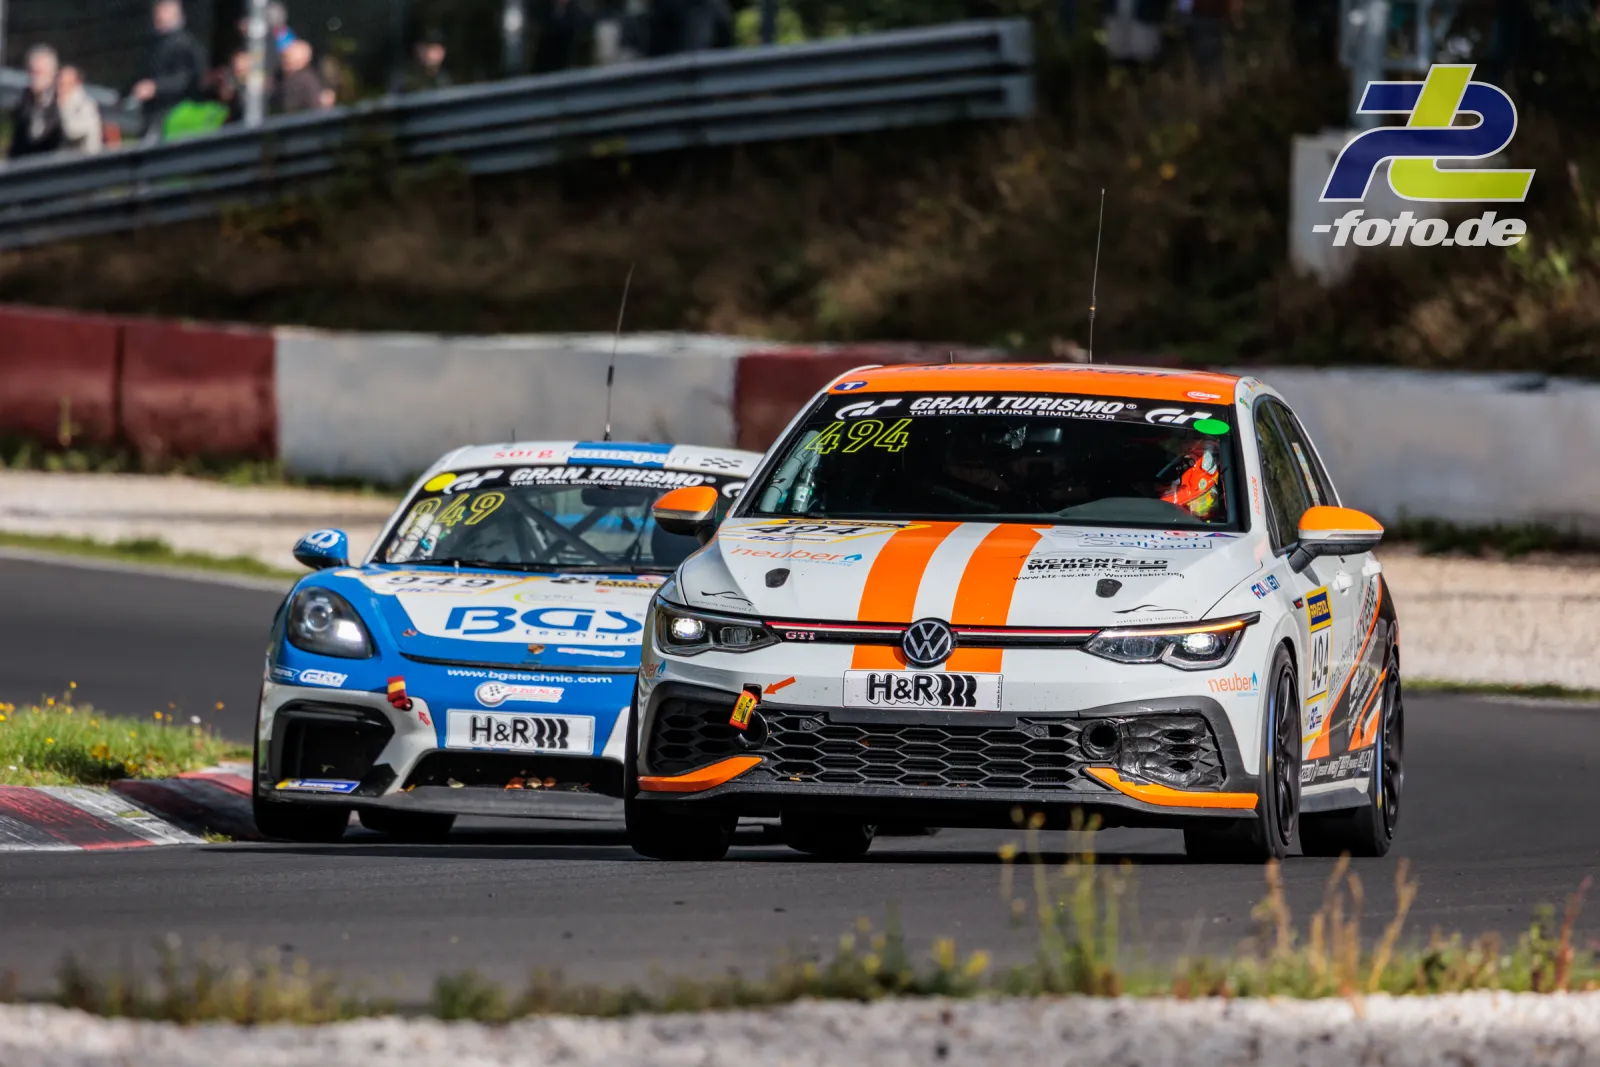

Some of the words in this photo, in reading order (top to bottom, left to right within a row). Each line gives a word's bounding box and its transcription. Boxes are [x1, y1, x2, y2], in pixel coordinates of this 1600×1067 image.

[909, 396, 993, 410] GRAN
[977, 408, 1033, 416] DRIVING
[1036, 411, 1115, 420] SIMULATOR
[804, 418, 913, 455] 494
[509, 466, 586, 481] GRAN
[747, 524, 867, 535] 494
[730, 547, 846, 561] neuber
[1029, 557, 1168, 566] SCHÖNFELD
[1027, 563, 1109, 571] WEBER
[1250, 574, 1281, 600] FALKEN
[445, 606, 643, 635] BGS
[525, 629, 637, 643] technic
[785, 631, 815, 641] GTI
[1311, 633, 1329, 691] 494
[447, 669, 613, 684] www.bgstechnic.com
[1208, 672, 1252, 693] neuber
[868, 673, 937, 703] H&R
[471, 715, 531, 745] H&R
